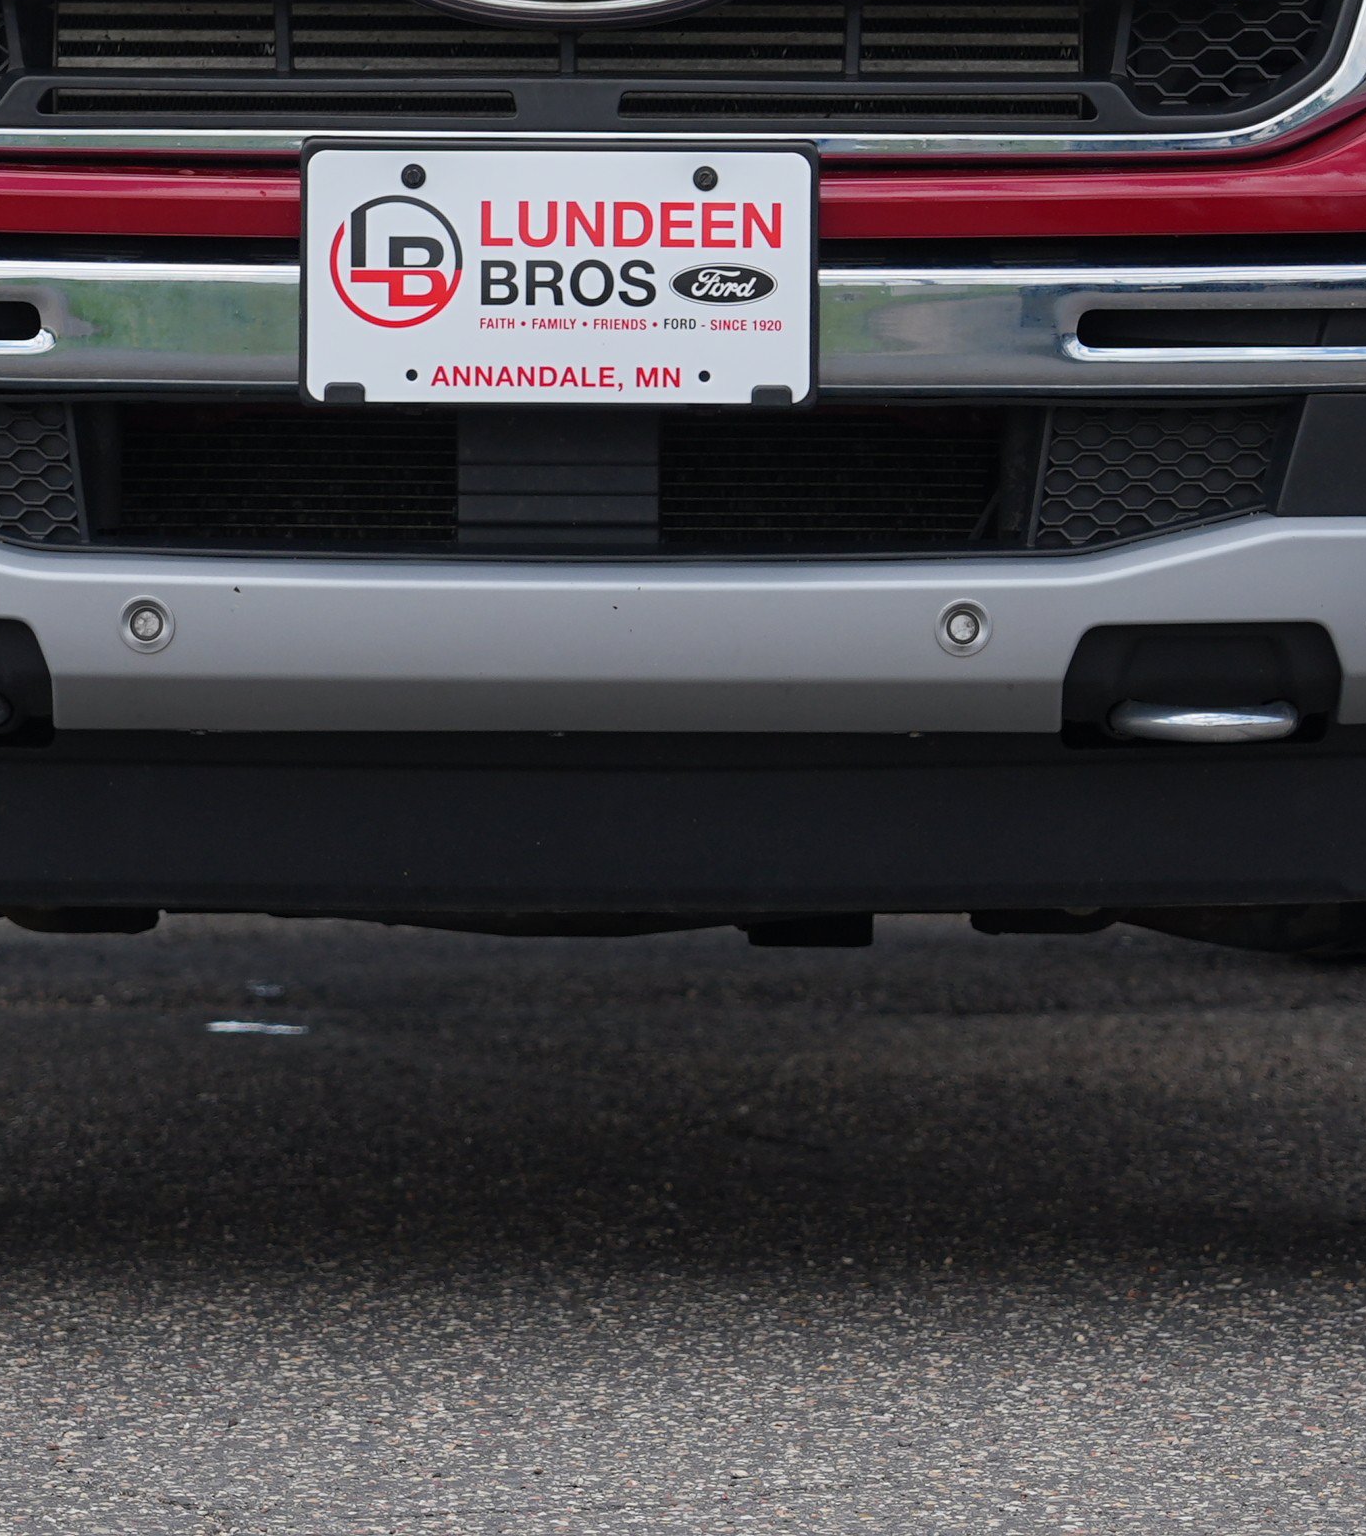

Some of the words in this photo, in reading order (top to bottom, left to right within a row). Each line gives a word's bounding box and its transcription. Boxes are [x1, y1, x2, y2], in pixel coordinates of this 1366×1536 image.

[480, 200, 782, 249] LUNDEEN
[480, 258, 657, 308] BROS
[690, 268, 757, 298] Ford
[479, 317, 515, 330] FAITH
[531, 317, 577, 330] FAMILY
[593, 318, 647, 331] FRIENDS
[663, 318, 697, 330] FORD
[710, 319, 747, 332] SINCE
[752, 319, 782, 332] 1920
[430, 365, 624, 392] ANNANDALE,
[635, 366, 681, 389] MN
